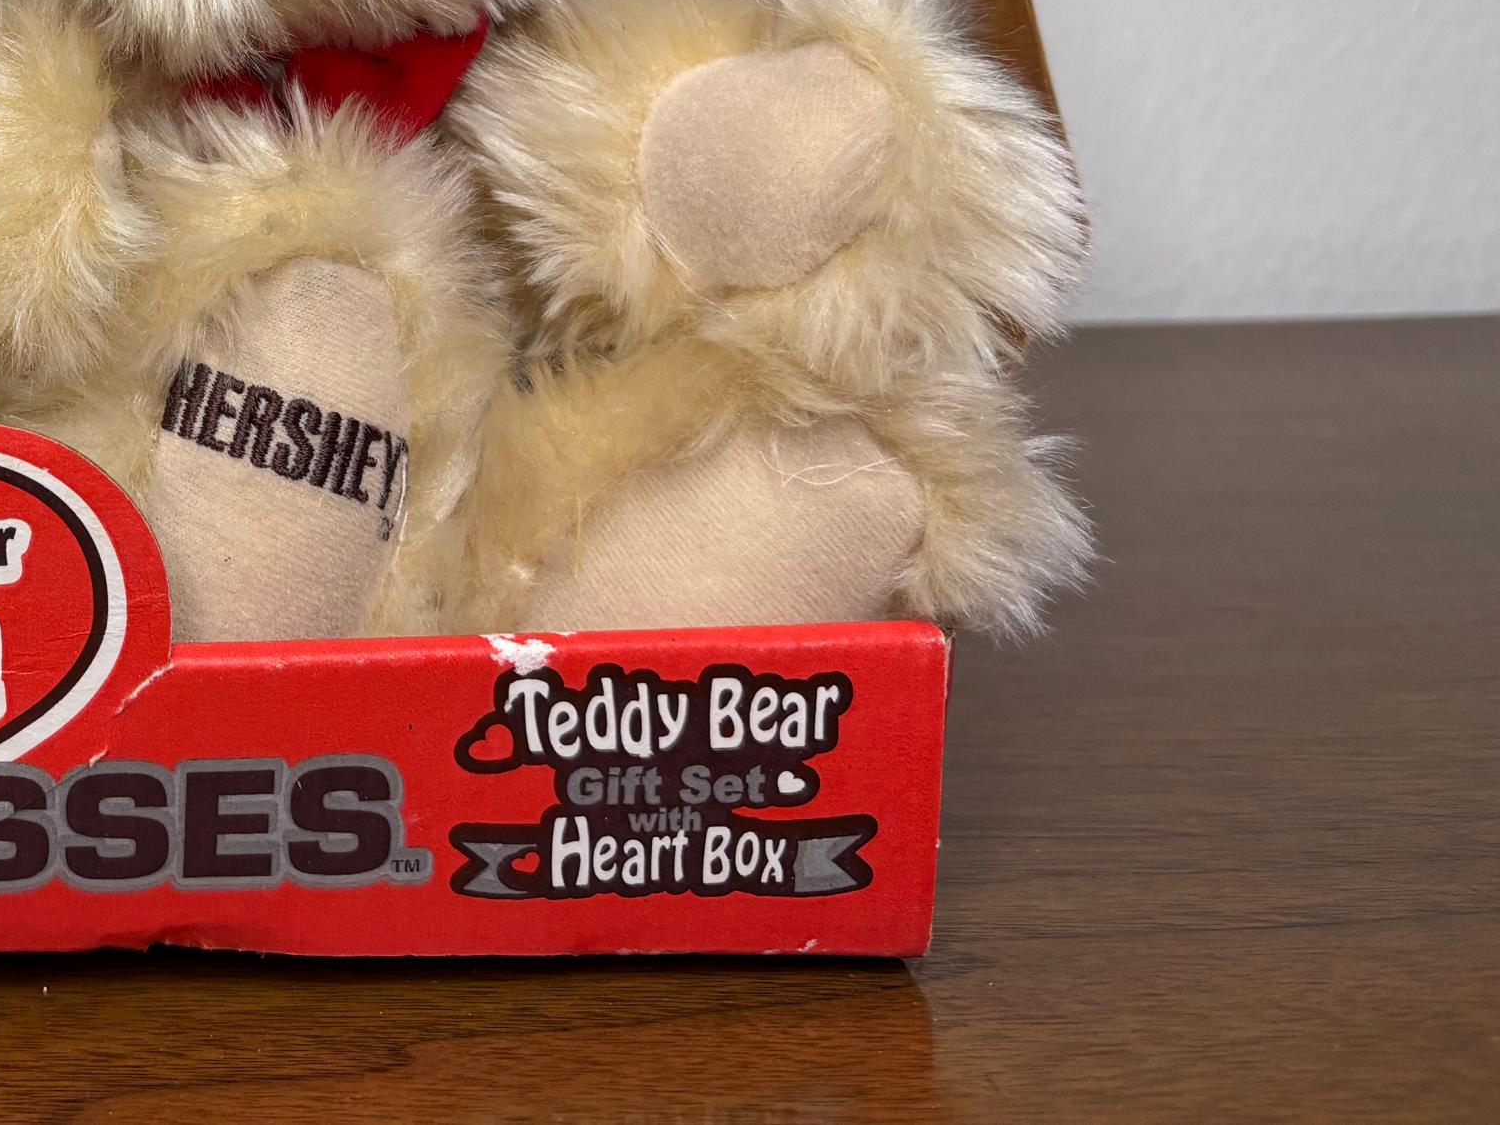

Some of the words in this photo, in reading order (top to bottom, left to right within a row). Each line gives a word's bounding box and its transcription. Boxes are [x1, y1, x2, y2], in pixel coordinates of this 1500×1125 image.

[504, 677, 689, 758] Teddy
[709, 676, 839, 752] Bear
[566, 765, 663, 806] Gift
[678, 764, 766, 804] Set
[628, 805, 702, 833] with
[550, 815, 689, 889] Heart
[701, 825, 787, 885] Box
